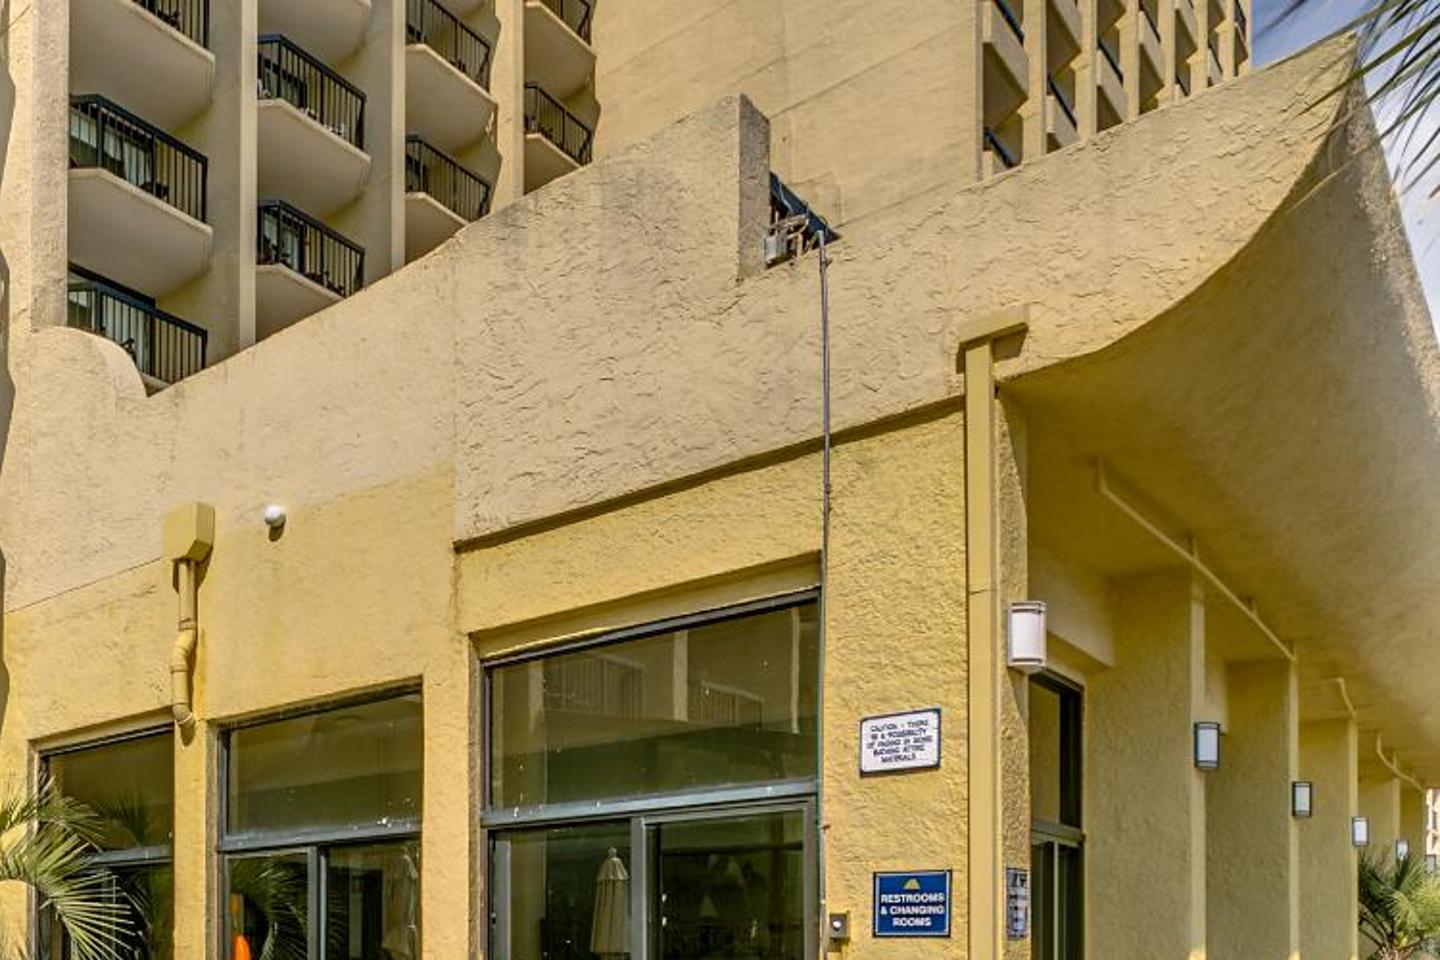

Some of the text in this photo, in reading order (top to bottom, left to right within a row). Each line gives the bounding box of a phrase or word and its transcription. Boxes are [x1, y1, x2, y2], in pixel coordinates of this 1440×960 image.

[881, 892, 945, 903] RESTROOMS
[880, 905, 945, 915] & CHANGING
[892, 917, 932, 927] ROOMS
